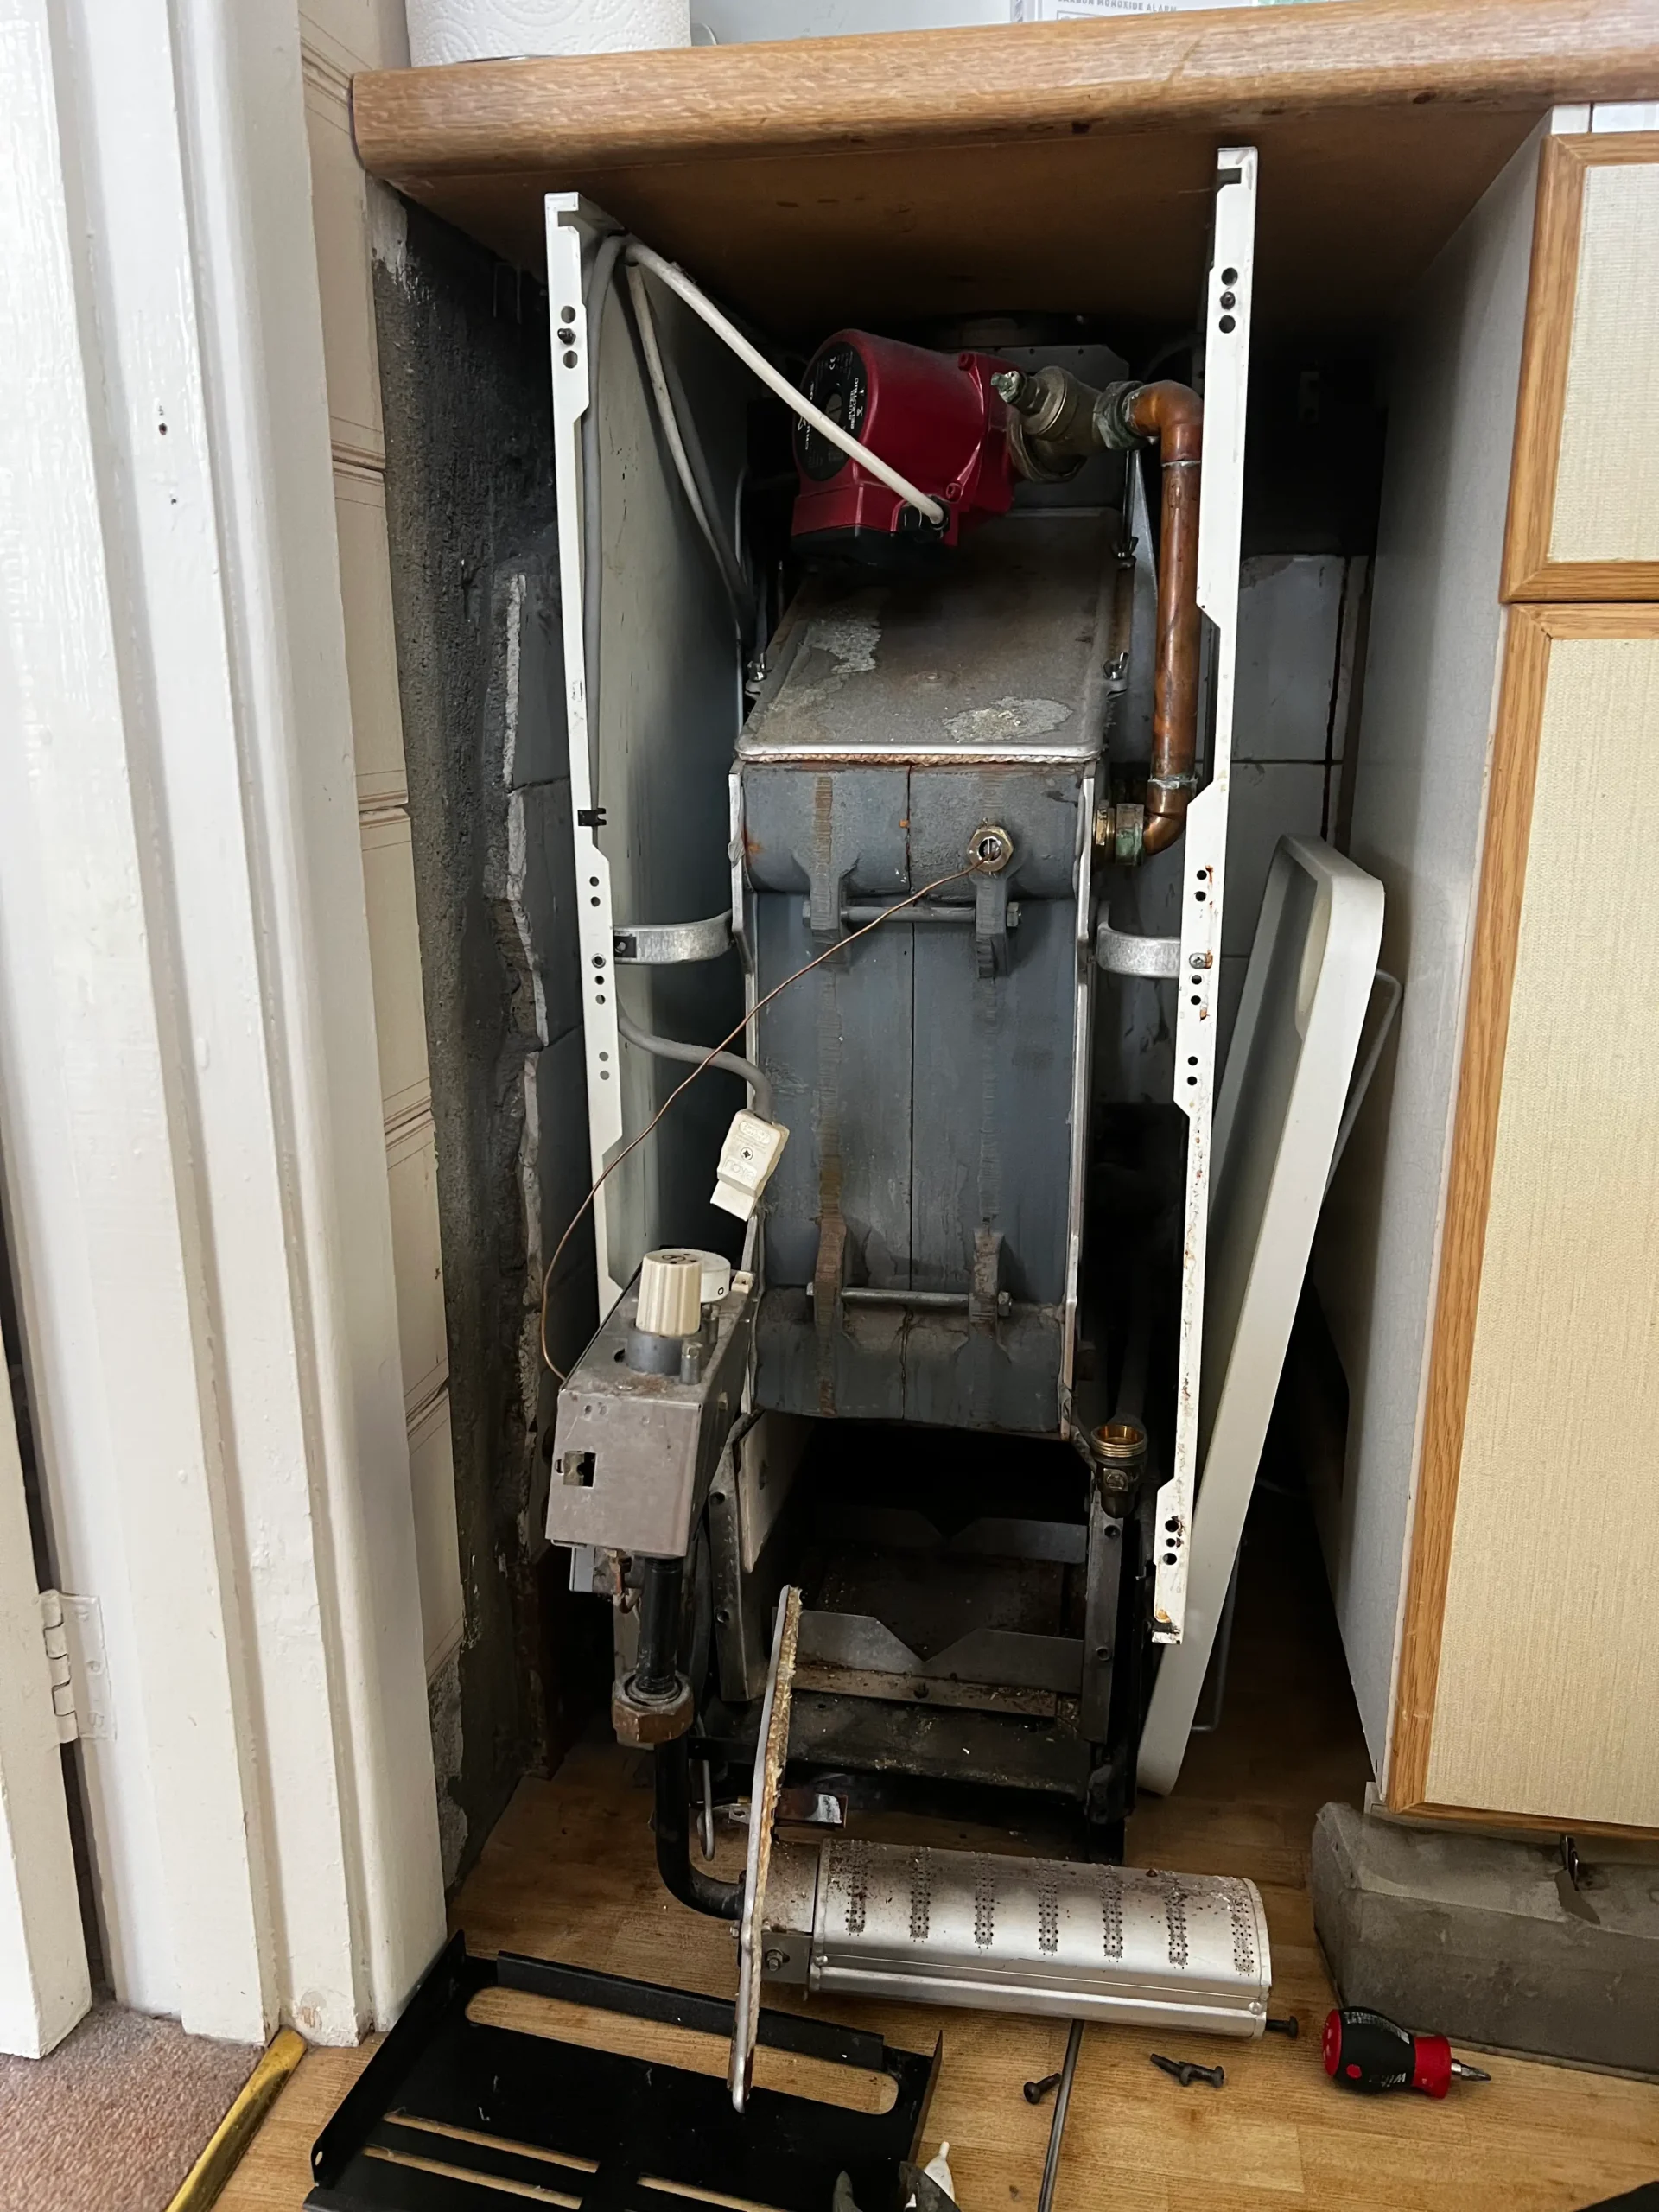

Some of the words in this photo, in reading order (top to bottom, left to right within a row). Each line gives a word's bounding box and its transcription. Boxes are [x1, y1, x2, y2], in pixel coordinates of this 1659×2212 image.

[1097, 0, 1144, 10] MONOXIDE
[1147, 3, 1177, 12] ALARM
[804, 382, 816, 451] GRUOS
